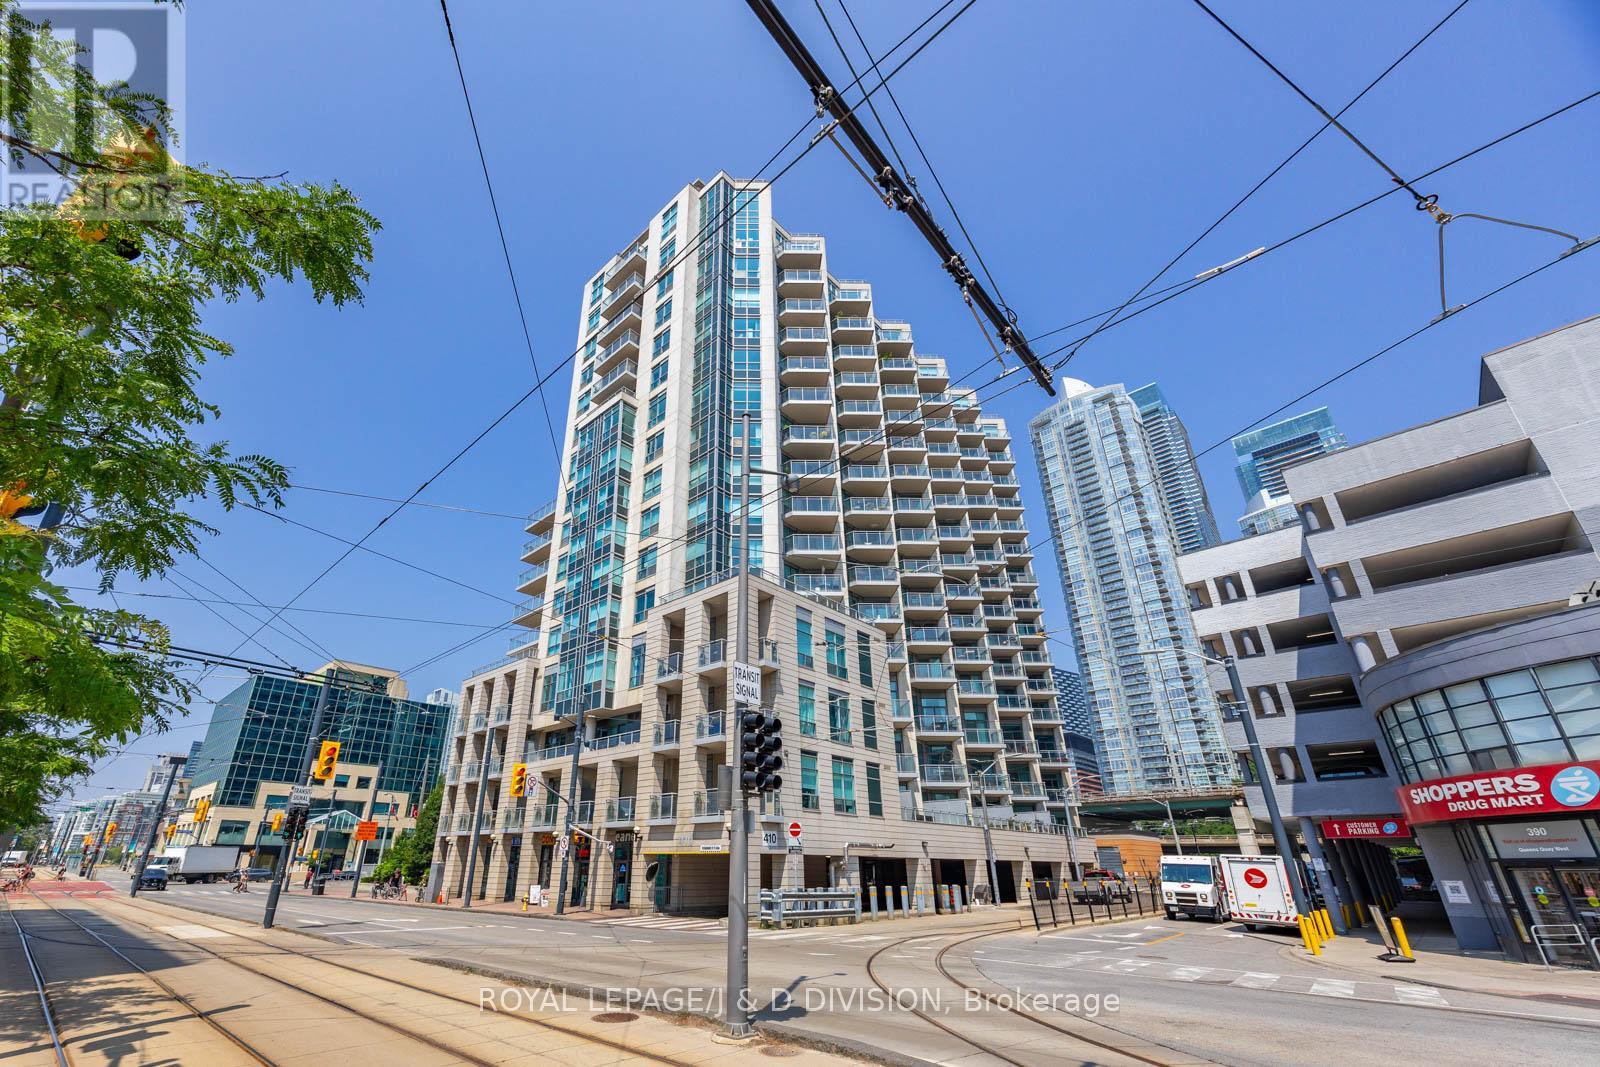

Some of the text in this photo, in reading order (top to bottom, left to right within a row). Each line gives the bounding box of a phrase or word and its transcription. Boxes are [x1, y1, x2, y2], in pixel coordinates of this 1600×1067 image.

[735, 666, 760, 684] TRANSIT
[735, 682, 759, 700] SIGNAL
[1410, 773, 1541, 805] SHOPPERS
[1448, 793, 1545, 812] DRUG MART
[763, 833, 777, 844] 410
[1526, 827, 1548, 836] 390
